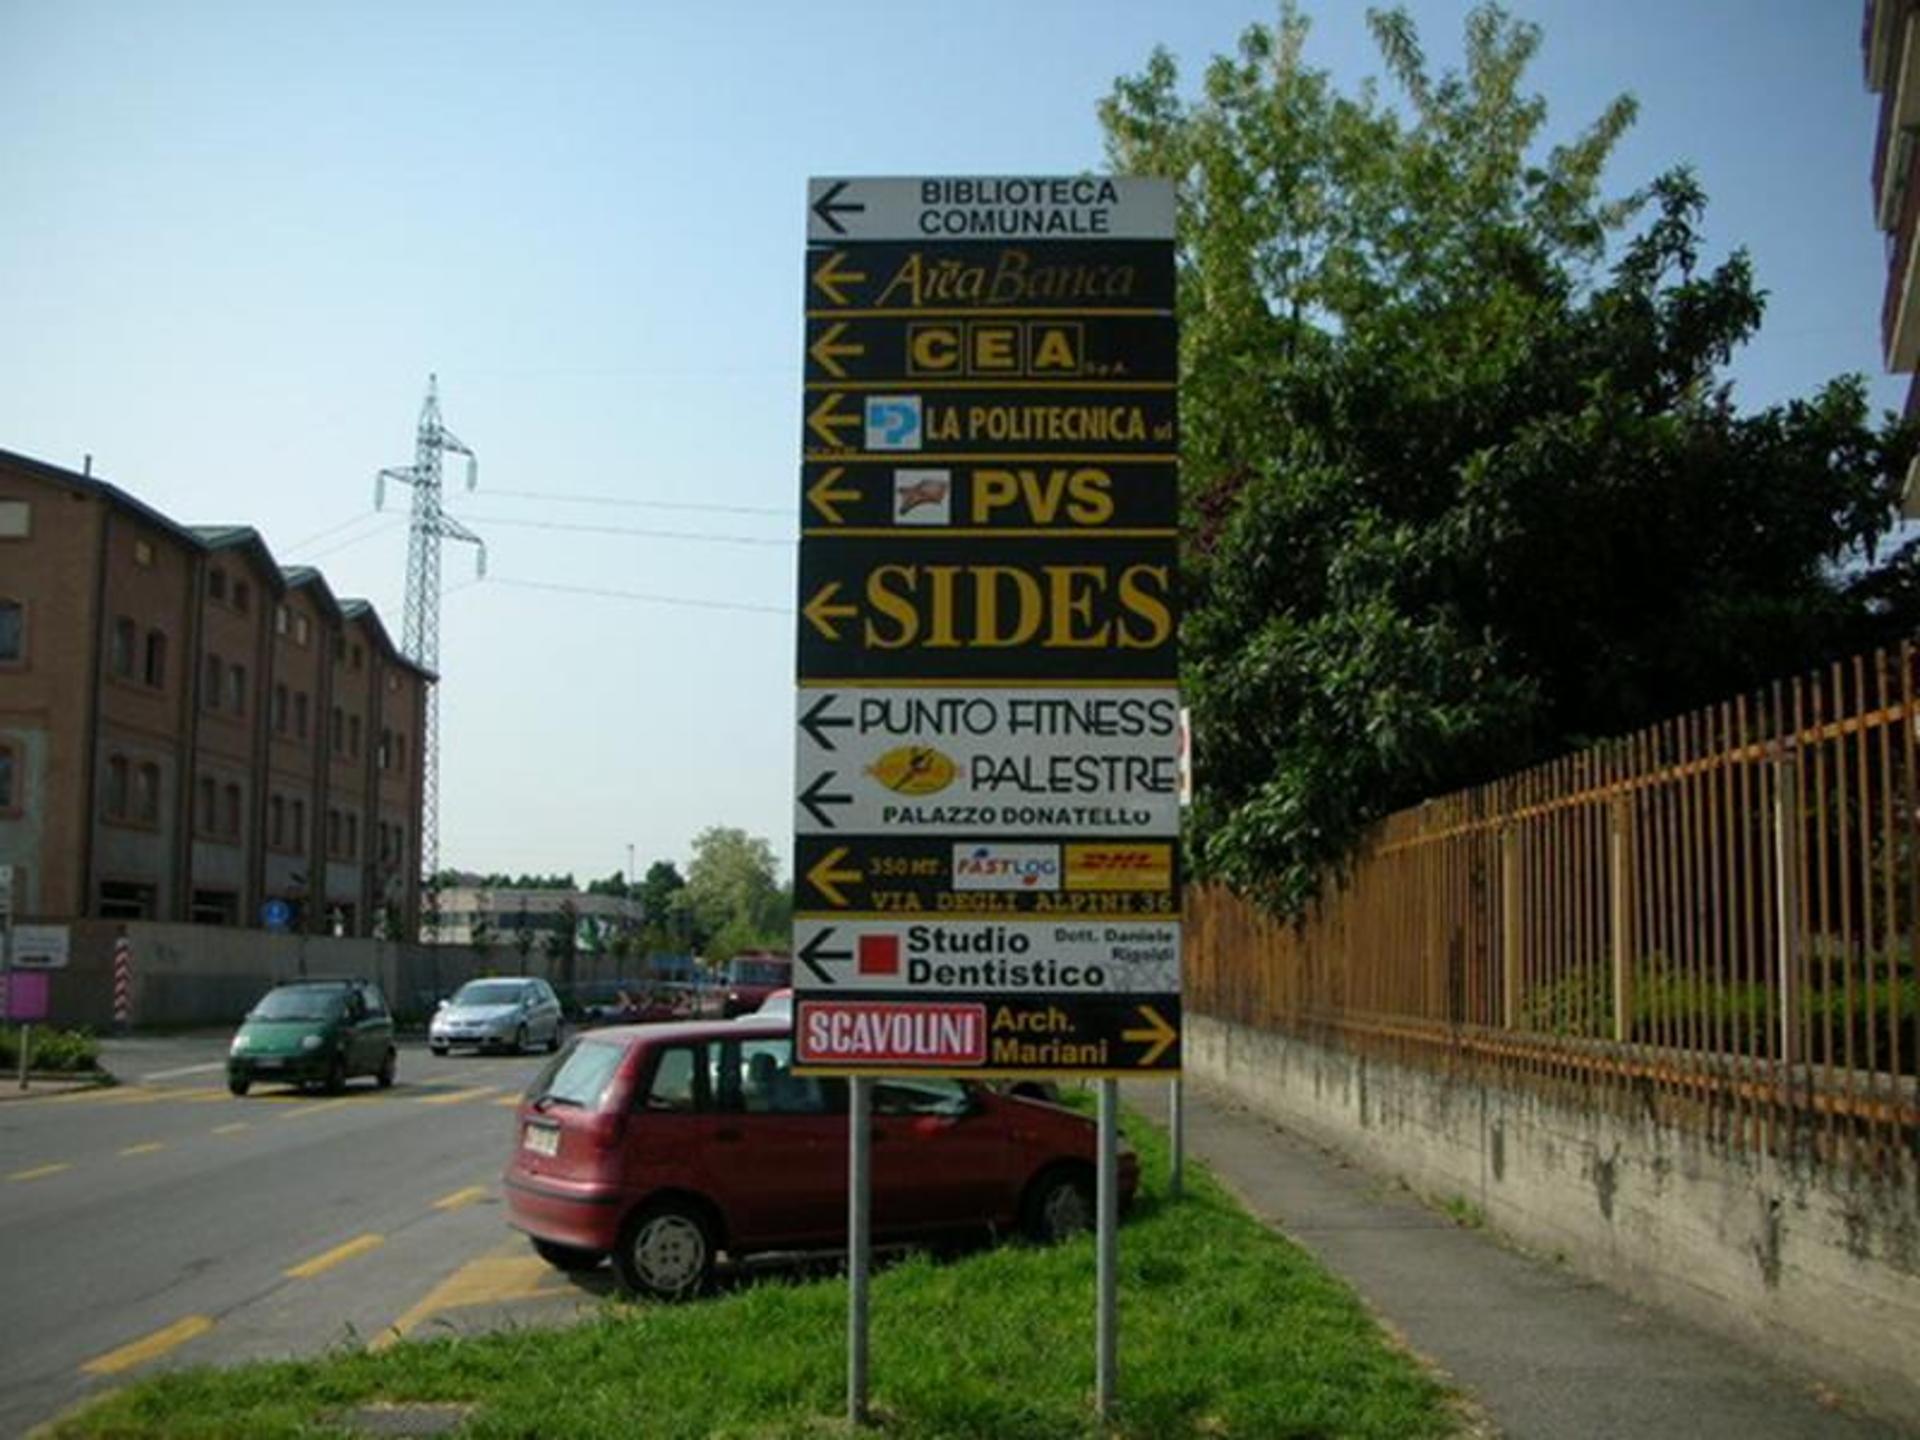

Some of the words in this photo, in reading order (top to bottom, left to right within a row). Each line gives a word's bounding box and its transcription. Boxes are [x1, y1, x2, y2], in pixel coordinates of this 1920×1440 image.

[921, 180, 1118, 205] BIBLIOTECA
[919, 209, 1109, 233] COMUNALE
[912, 330, 1076, 369] CEA
[926, 407, 961, 440] LA
[969, 406, 1145, 440] POLITECNICA
[971, 468, 1115, 525] PVS
[864, 564, 1172, 649] SIDES
[860, 699, 997, 735] PUNTO
[1008, 699, 1174, 735] FITNESS
[971, 755, 1175, 793] PALESTRE
[883, 807, 997, 825] PALAZZO
[1002, 807, 1151, 825] DONATELLO
[957, 858, 1057, 875] FASTLOG
[871, 892, 921, 911] VIA
[937, 892, 1015, 911] DEGLI
[1035, 892, 1131, 911] ALPINI
[907, 926, 1030, 953] Studio
[1054, 928, 1100, 943] Dott.
[1104, 928, 1173, 943] Daniele
[907, 959, 1105, 987] Dentistico
[992, 1007, 1076, 1032] Arch.
[809, 1011, 975, 1056] SCAVOLINI
[992, 1039, 1107, 1065] Mariani
